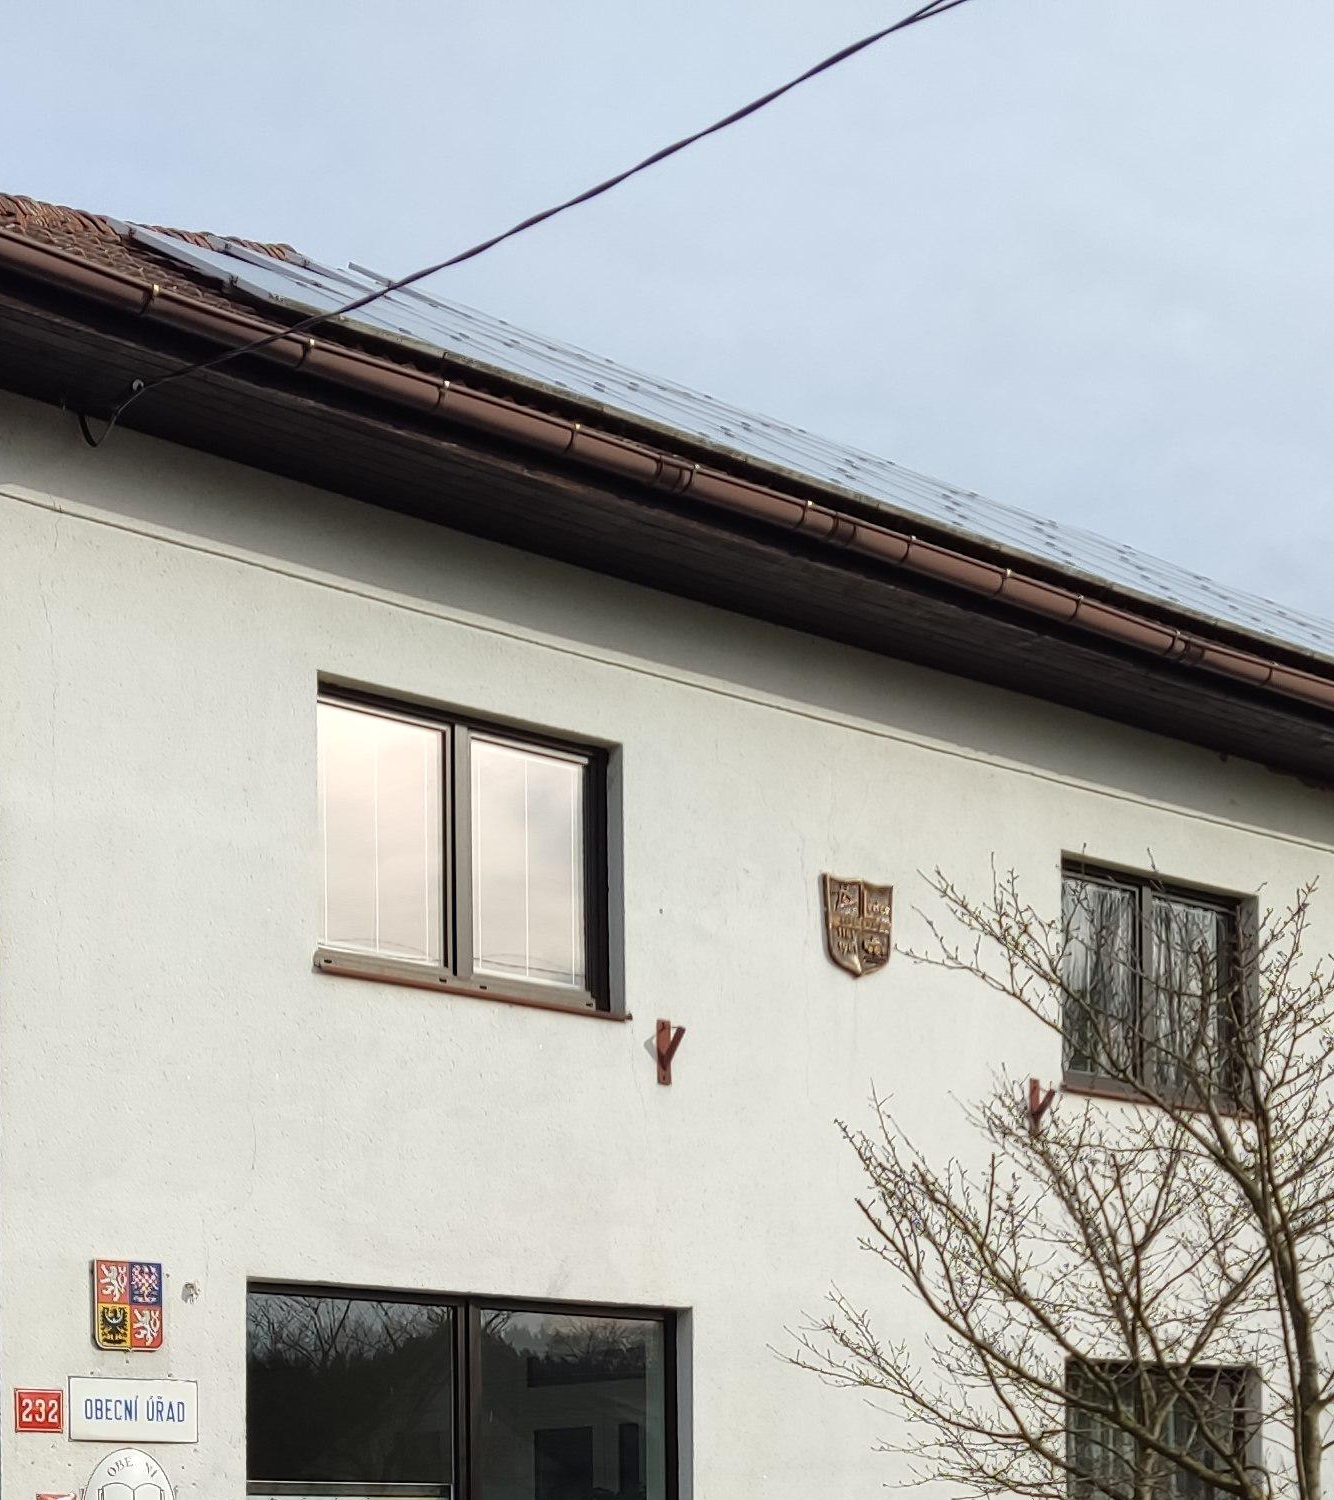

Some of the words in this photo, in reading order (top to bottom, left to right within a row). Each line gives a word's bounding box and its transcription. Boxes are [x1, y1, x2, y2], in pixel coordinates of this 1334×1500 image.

[21, 1398, 58, 1423] 232
[84, 1395, 138, 1421] OBECNÍ
[146, 1395, 185, 1422] ÚŘAD
